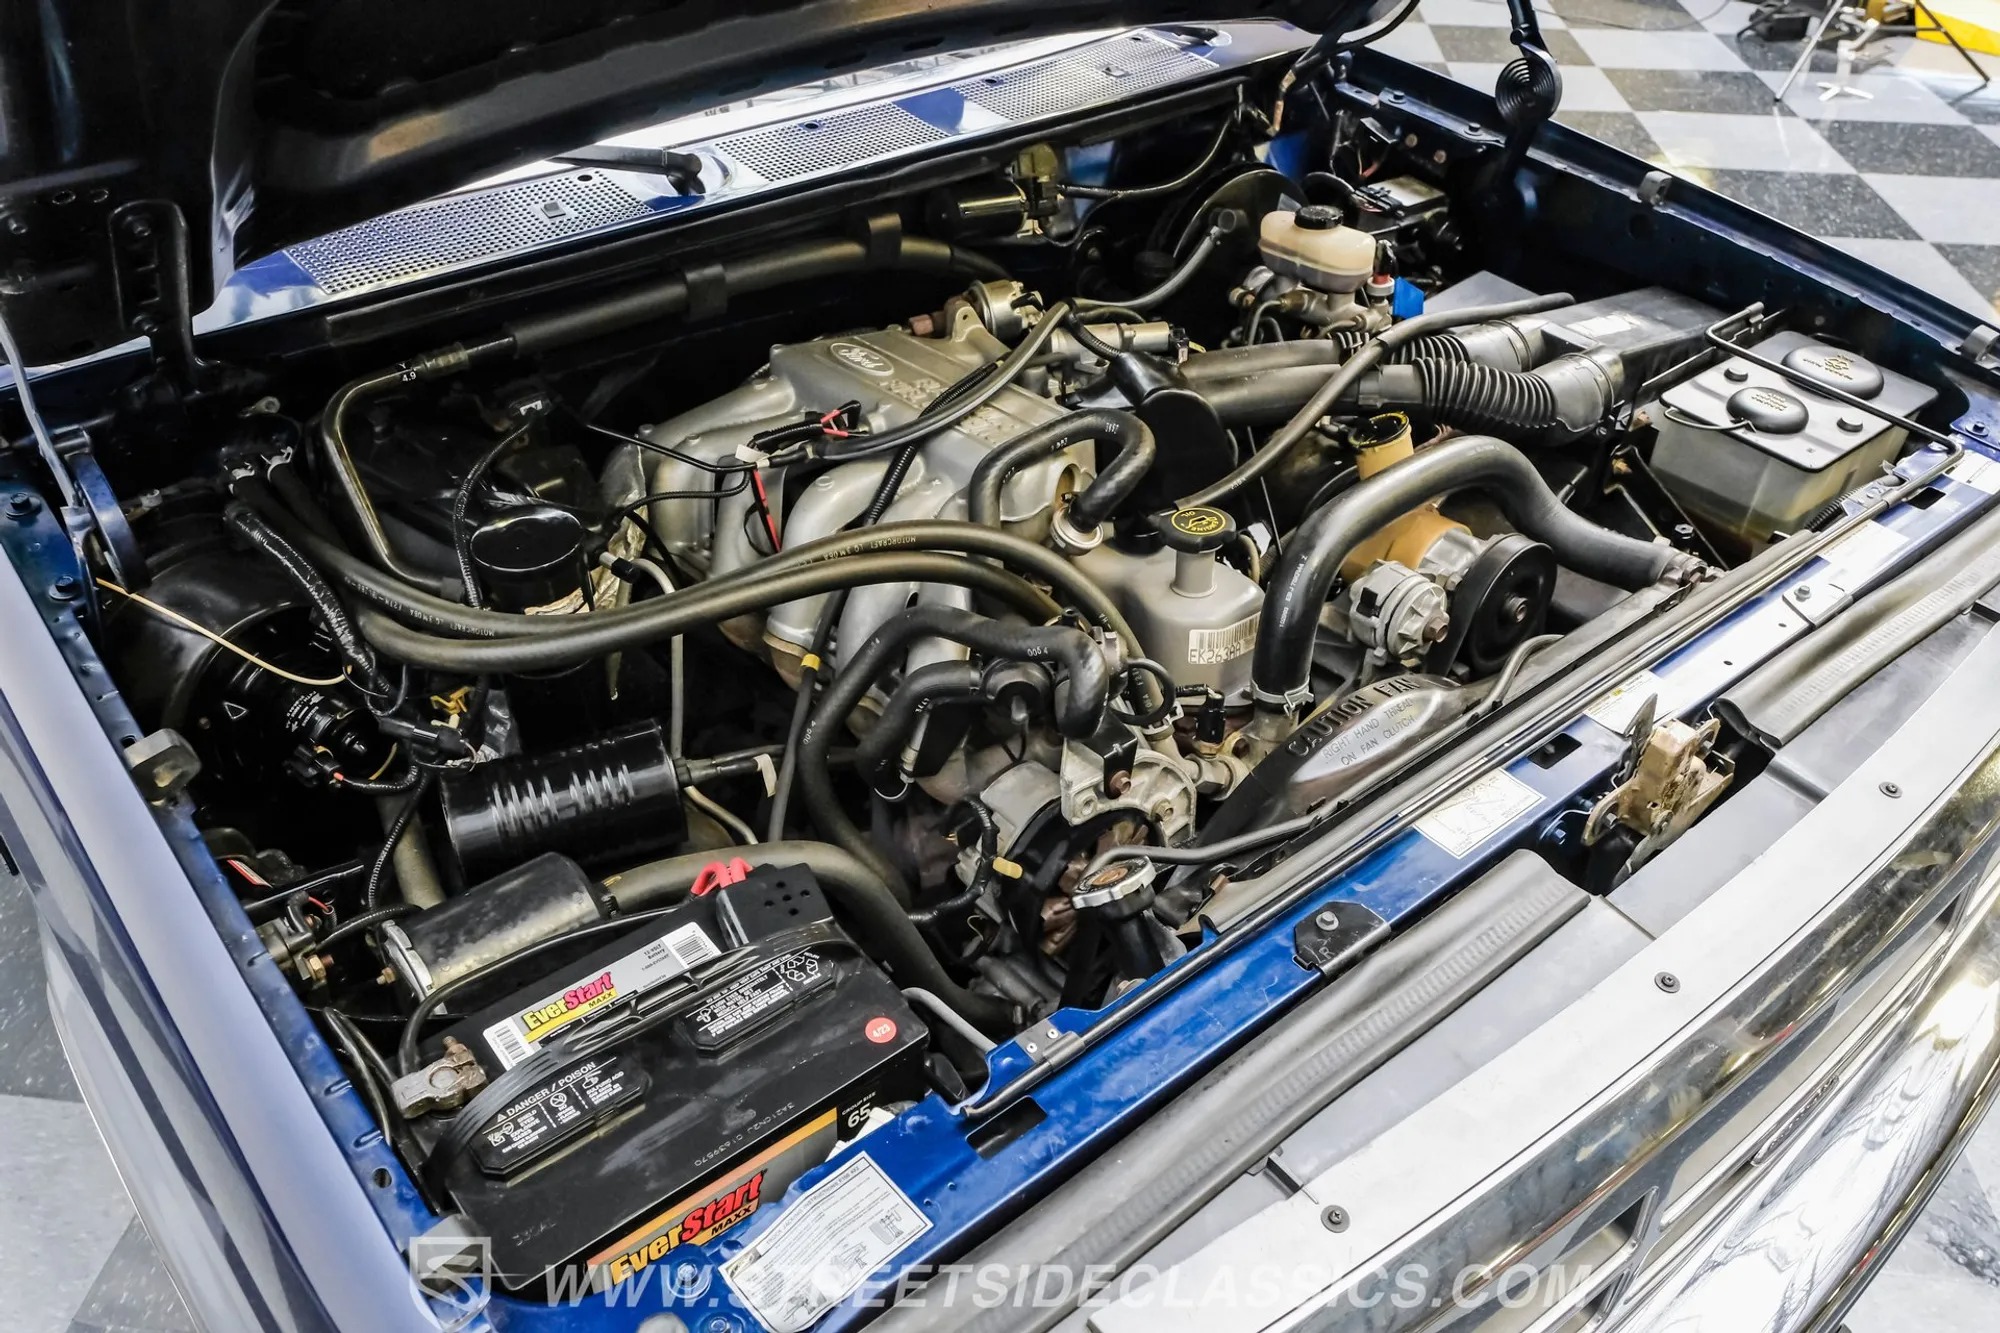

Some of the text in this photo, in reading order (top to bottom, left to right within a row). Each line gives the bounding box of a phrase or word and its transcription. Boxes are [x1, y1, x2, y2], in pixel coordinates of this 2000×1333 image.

[1287, 676, 1421, 757] CAUTION FAN
[1324, 734, 1351, 759] RIGHT
[1354, 718, 1380, 739] HAND
[1341, 714, 1416, 766] ON FAN CLUTCH
[521, 971, 615, 1031] EverStart
[588, 991, 614, 1009] MAXX
[506, 1087, 549, 1116] DANGER
[557, 1060, 596, 1087] POISON
[847, 1103, 872, 1128] 65
[609, 1170, 765, 1285] EverStart
[710, 1205, 752, 1236] MAXX
